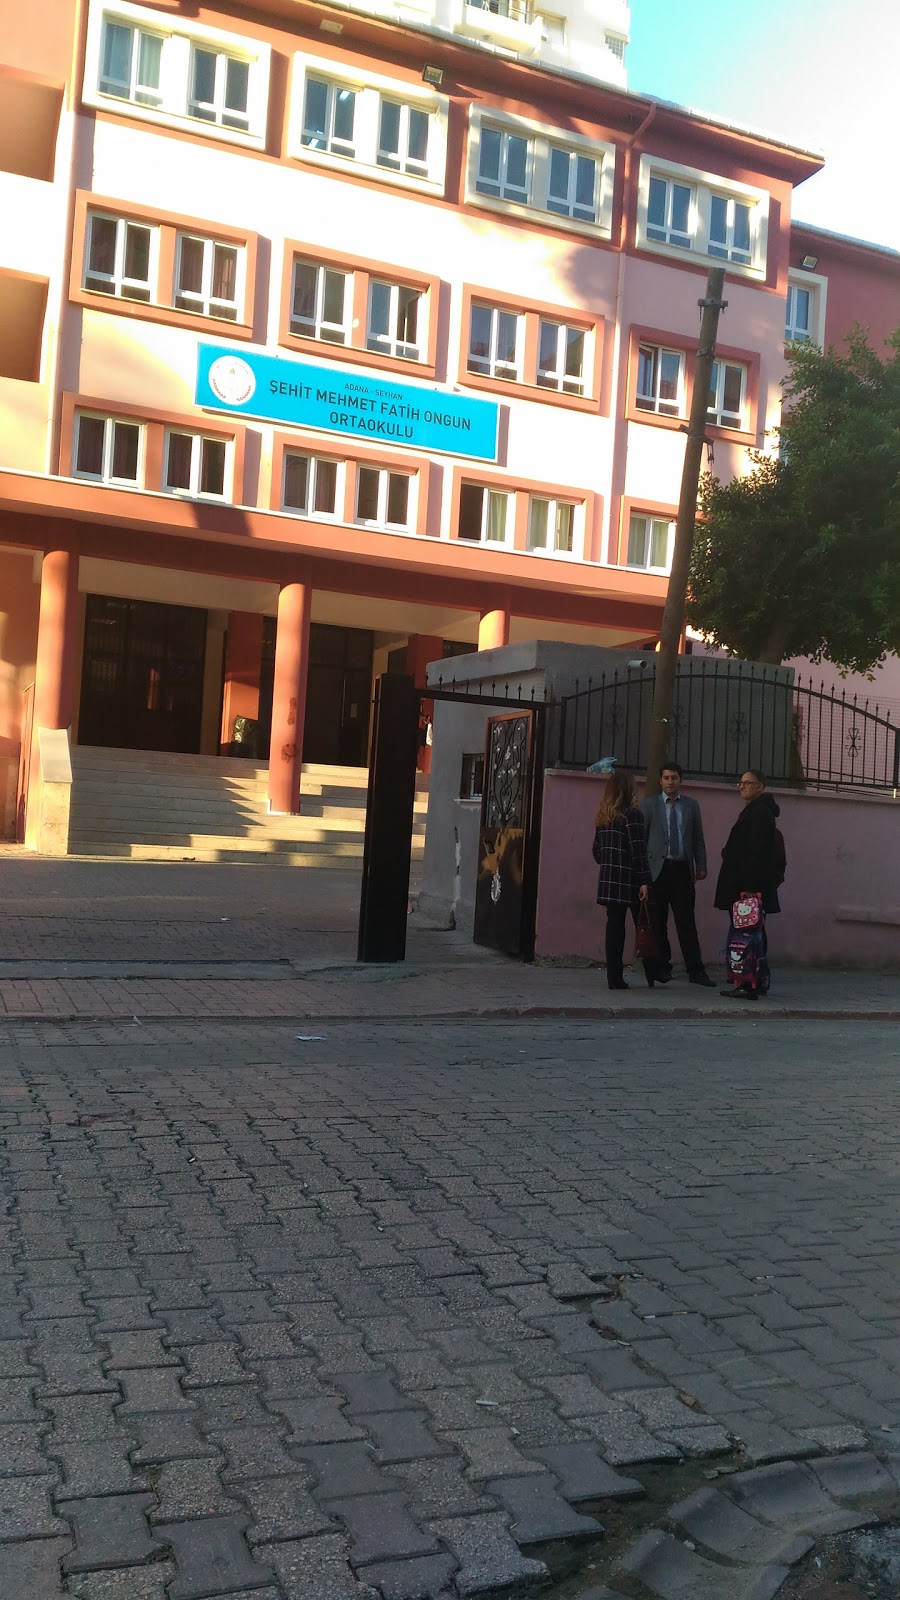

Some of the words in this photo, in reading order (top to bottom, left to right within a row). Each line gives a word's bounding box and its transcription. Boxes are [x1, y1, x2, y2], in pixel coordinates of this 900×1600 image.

[344, 383, 369, 394] ADANA
[375, 389, 403, 400] SEYHAN
[269, 380, 312, 400] ŞEHİT
[316, 389, 377, 412] MEHMET
[380, 402, 420, 421] FATİH
[423, 410, 471, 431] ONGUN
[329, 411, 414, 438] ORTAOKULU
